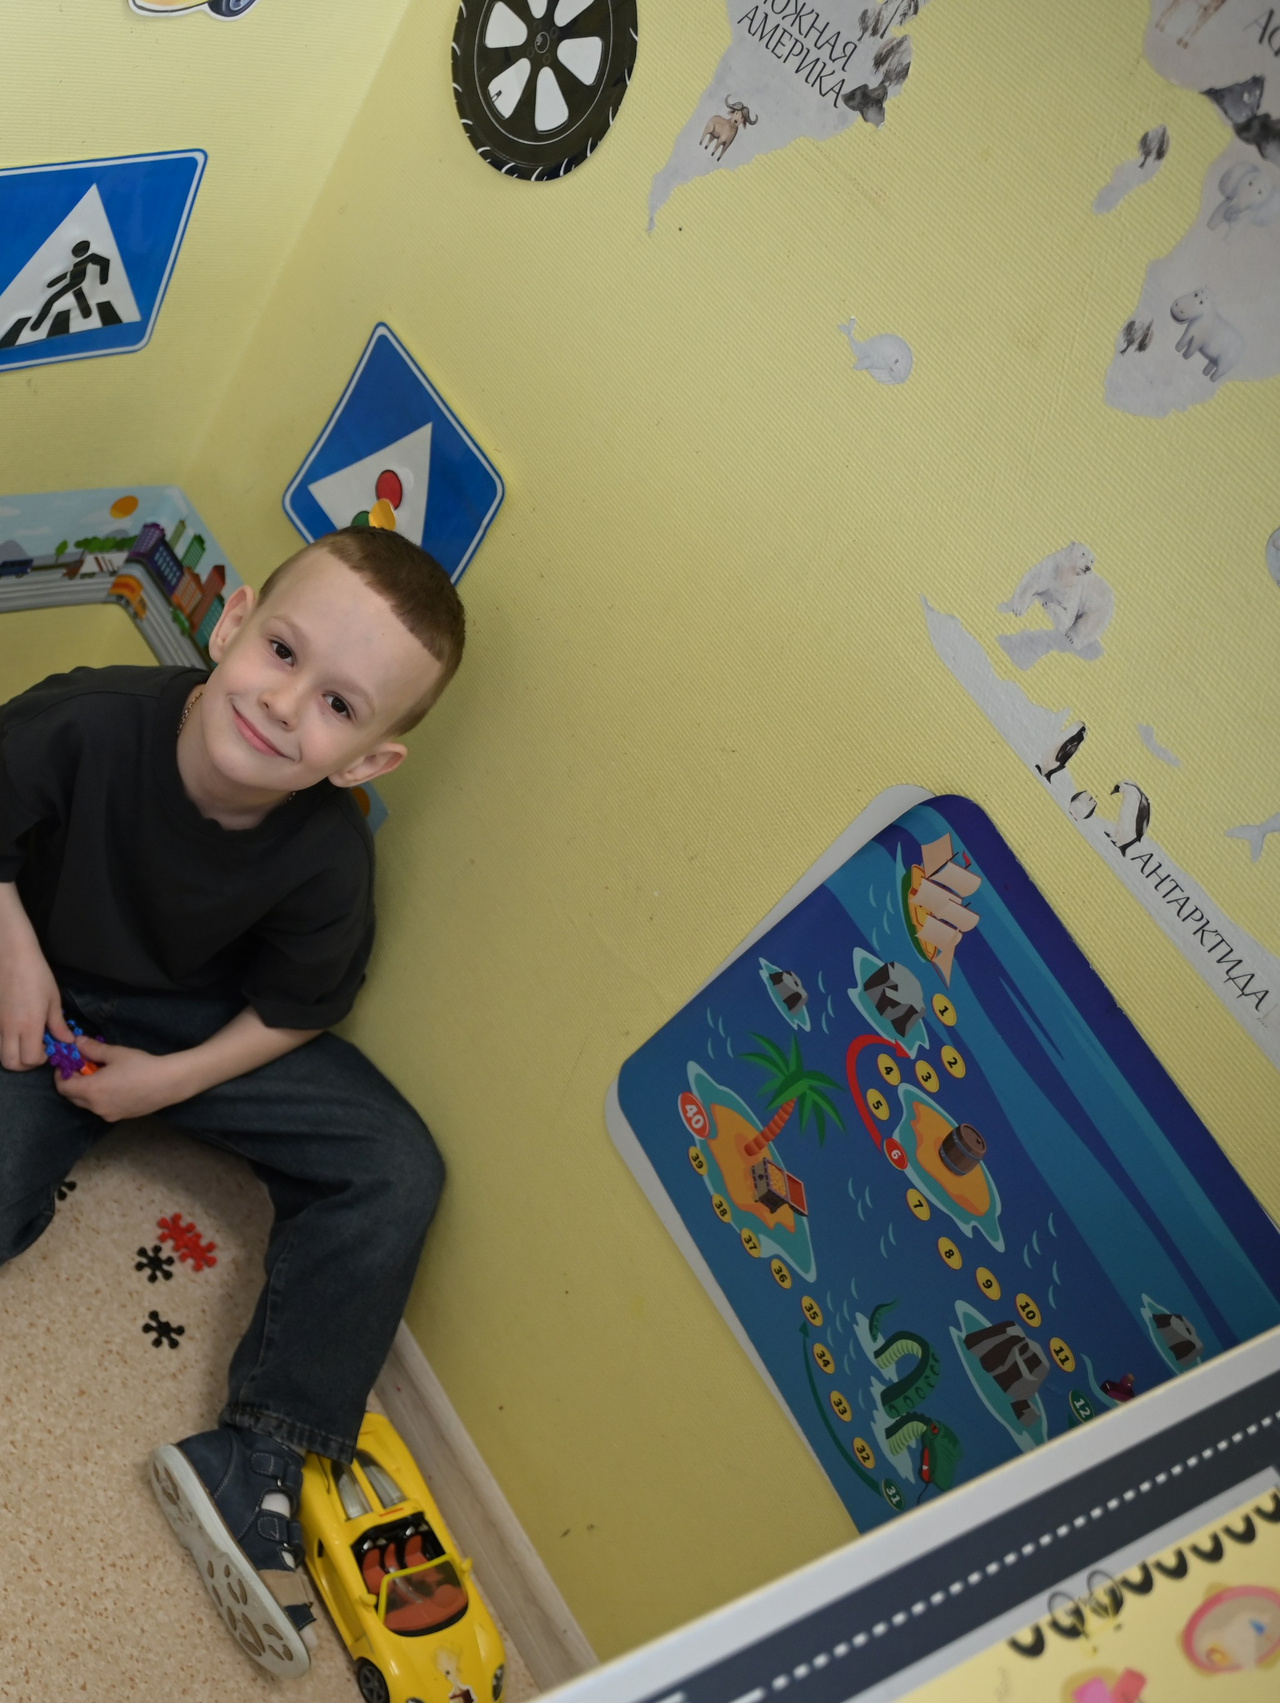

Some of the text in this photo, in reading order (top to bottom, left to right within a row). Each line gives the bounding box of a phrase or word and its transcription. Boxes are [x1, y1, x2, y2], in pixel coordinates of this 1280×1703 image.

[737, 5, 846, 108] АМЕРИКА
[1130, 852, 1269, 1012] АНТАРКТИДА
[938, 1005, 949, 1017] 1
[884, 1065, 894, 1075] 4
[947, 1057, 958, 1069] 2
[921, 1072, 932, 1082] 3
[872, 1100, 883, 1111] 5
[685, 1104, 704, 1129] 40
[691, 1152, 704, 1169] 39
[891, 1149, 902, 1160] 6
[714, 1200, 728, 1217] 38
[913, 1199, 924, 1209] 7
[743, 1235, 757, 1251] 37
[944, 1249, 955, 1259] 8
[773, 1266, 788, 1283] 36
[982, 1279, 993, 1289] 9
[804, 1303, 819, 1320] 35
[1019, 1301, 1036, 1320] 10
[816, 1350, 831, 1368] 34
[1053, 1346, 1070, 1366] 11
[833, 1397, 848, 1416] 33
[1073, 1398, 1091, 1418] 12
[856, 1444, 870, 1462] 32
[886, 1486, 901, 1504] 31
